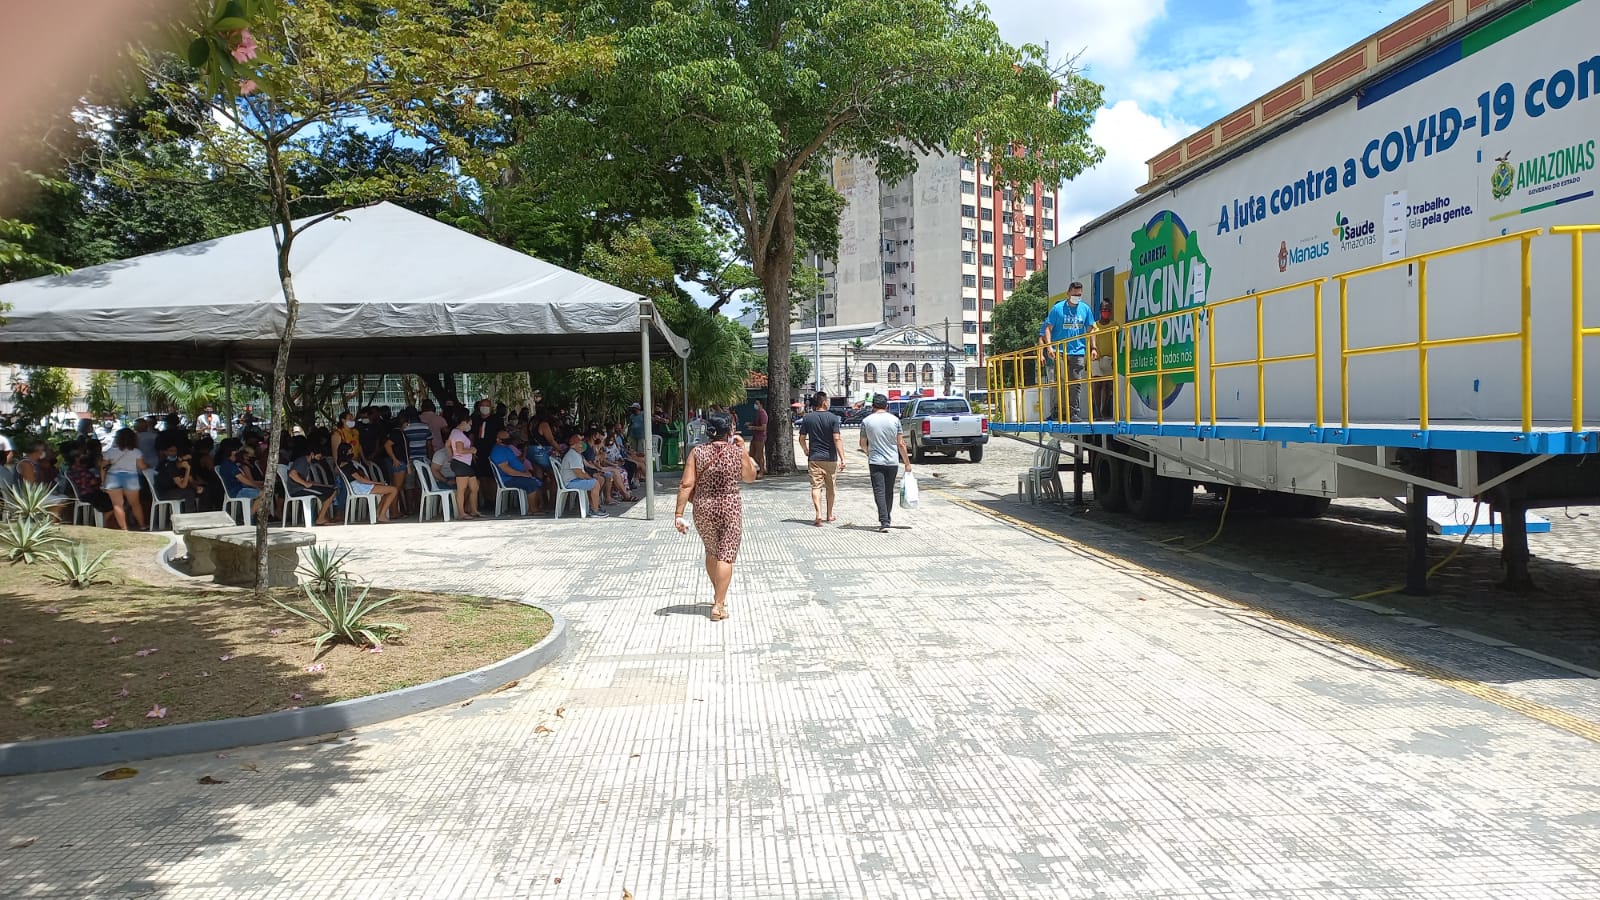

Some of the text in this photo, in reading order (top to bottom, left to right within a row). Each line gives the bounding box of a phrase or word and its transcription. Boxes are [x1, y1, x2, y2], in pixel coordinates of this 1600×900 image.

[1217, 205, 1230, 236] A
[1234, 196, 1266, 230] luta
[1271, 167, 1338, 215] contra
[1343, 158, 1356, 188] a
[1362, 82, 1515, 179] COVID-19
[1517, 139, 1595, 190] AMAZONAS
[1413, 197, 1450, 215] trabalho
[1422, 212, 1442, 229] pela
[1443, 205, 1473, 223] gente.
[1289, 241, 1330, 265] Manaus
[1341, 235, 1377, 251] Amazonas
[1139, 245, 1167, 266] CARRETA
[1162, 351, 1180, 364] todos
[1180, 348, 1193, 362] nós
